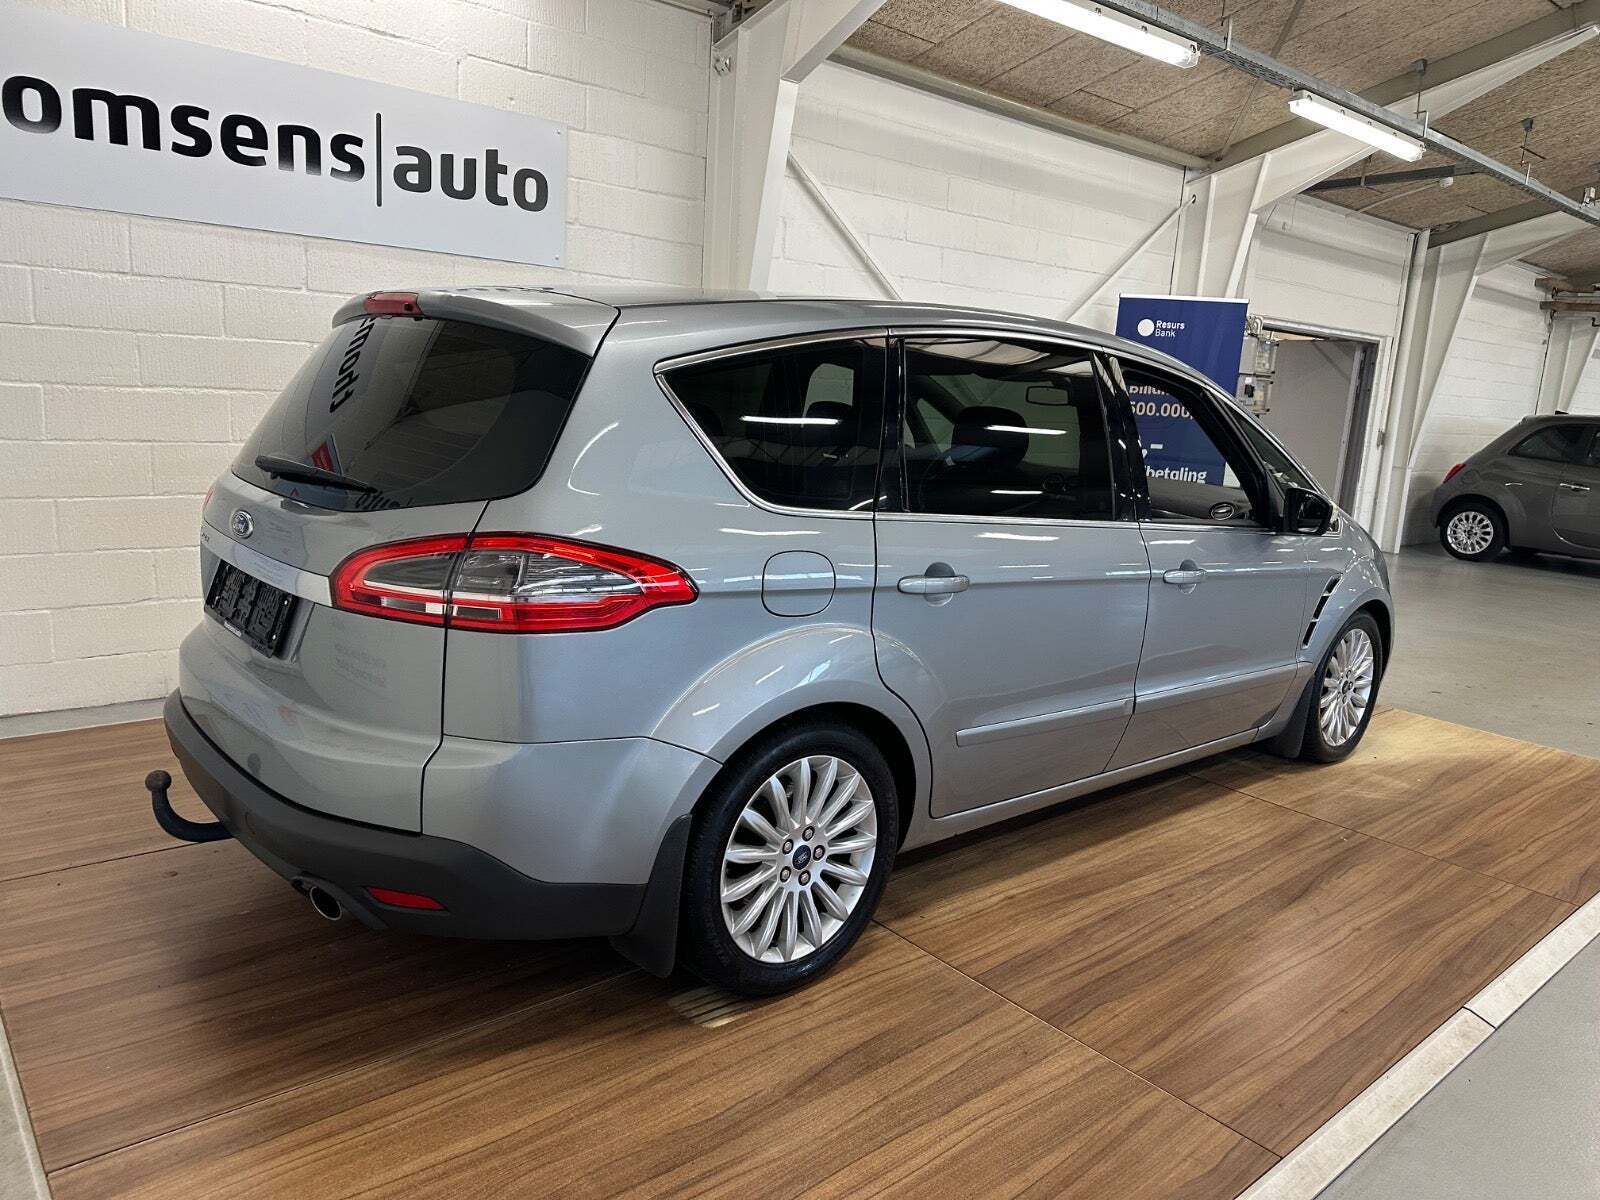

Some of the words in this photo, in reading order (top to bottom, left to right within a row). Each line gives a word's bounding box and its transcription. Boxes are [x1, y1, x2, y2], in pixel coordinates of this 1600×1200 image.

[393, 145, 549, 212] auto
[1156, 320, 1185, 330] Resurs
[1155, 329, 1176, 337] Bank
[1145, 465, 1207, 484] betaling
